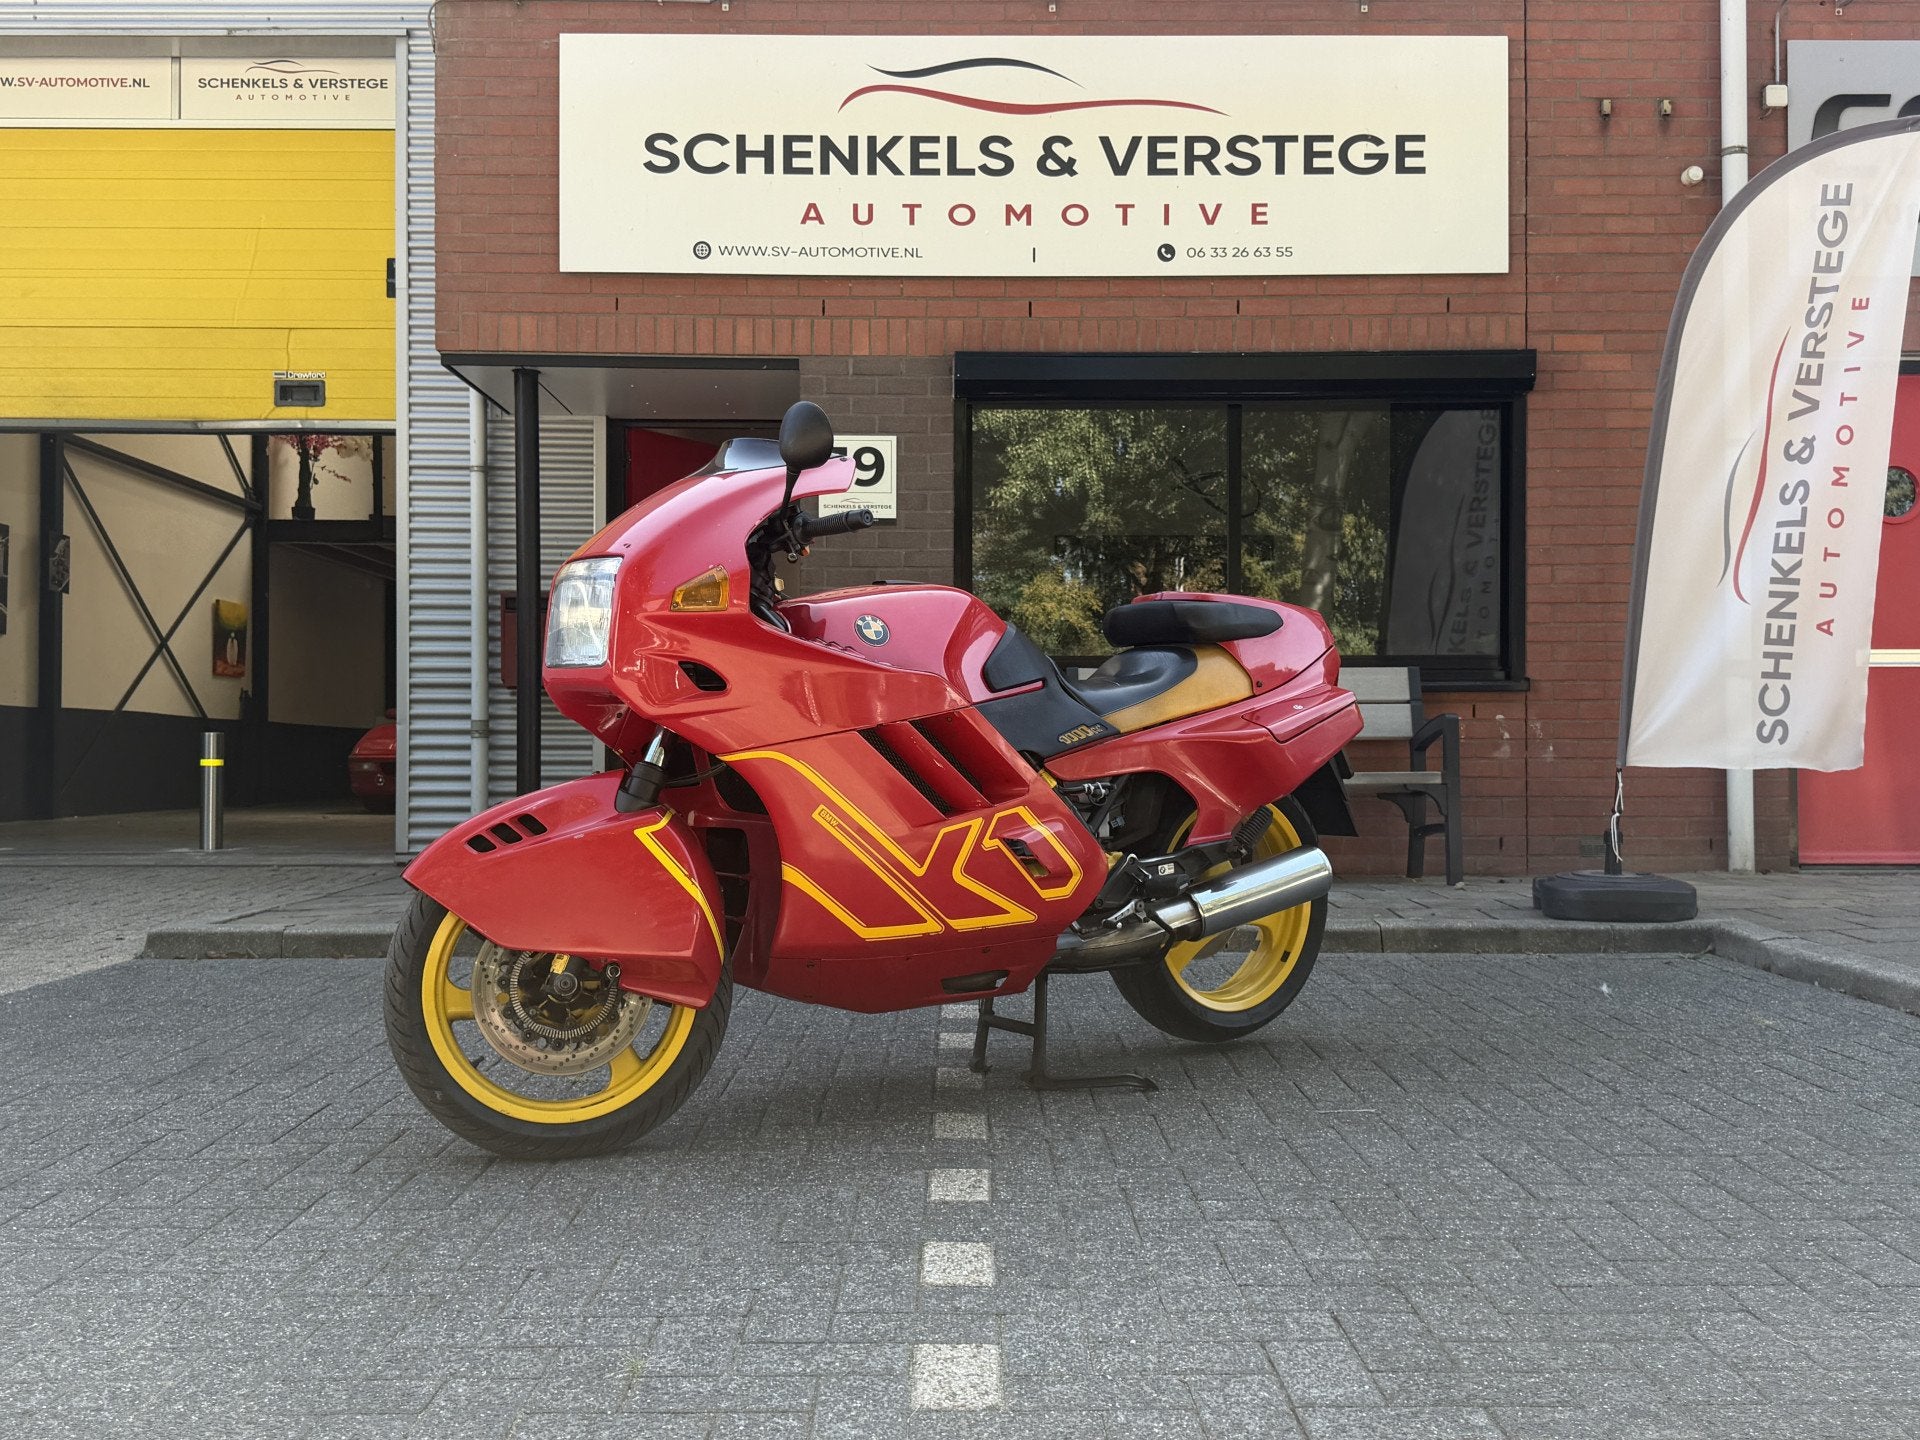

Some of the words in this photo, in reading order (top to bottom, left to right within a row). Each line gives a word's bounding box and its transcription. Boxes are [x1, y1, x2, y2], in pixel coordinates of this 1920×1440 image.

[197, 77, 288, 89] SCHENKELS
[293, 78, 304, 89] &
[308, 78, 389, 89] VERSTEGE
[642, 132, 1015, 177] SCHENKELS
[1036, 135, 1079, 177] &
[1098, 133, 1427, 177] VERSTEGE
[800, 202, 1269, 227] AUTOMOTIVE
[718, 245, 923, 259] WWW.SV-AUTOMOTIVE.NL
[1186, 246, 1206, 259] 06
[1209, 246, 1230, 259] 33
[1232, 246, 1250, 259] 26
[1253, 246, 1272, 259] 63
[1275, 246, 1293, 259] 55
[1787, 182, 1853, 421] VERSTEGE
[1783, 435, 1816, 465] &
[1816, 297, 1870, 637] AUTOMOTIVE
[1756, 479, 1810, 745] SCHENKELS
[818, 808, 839, 827] BMW
